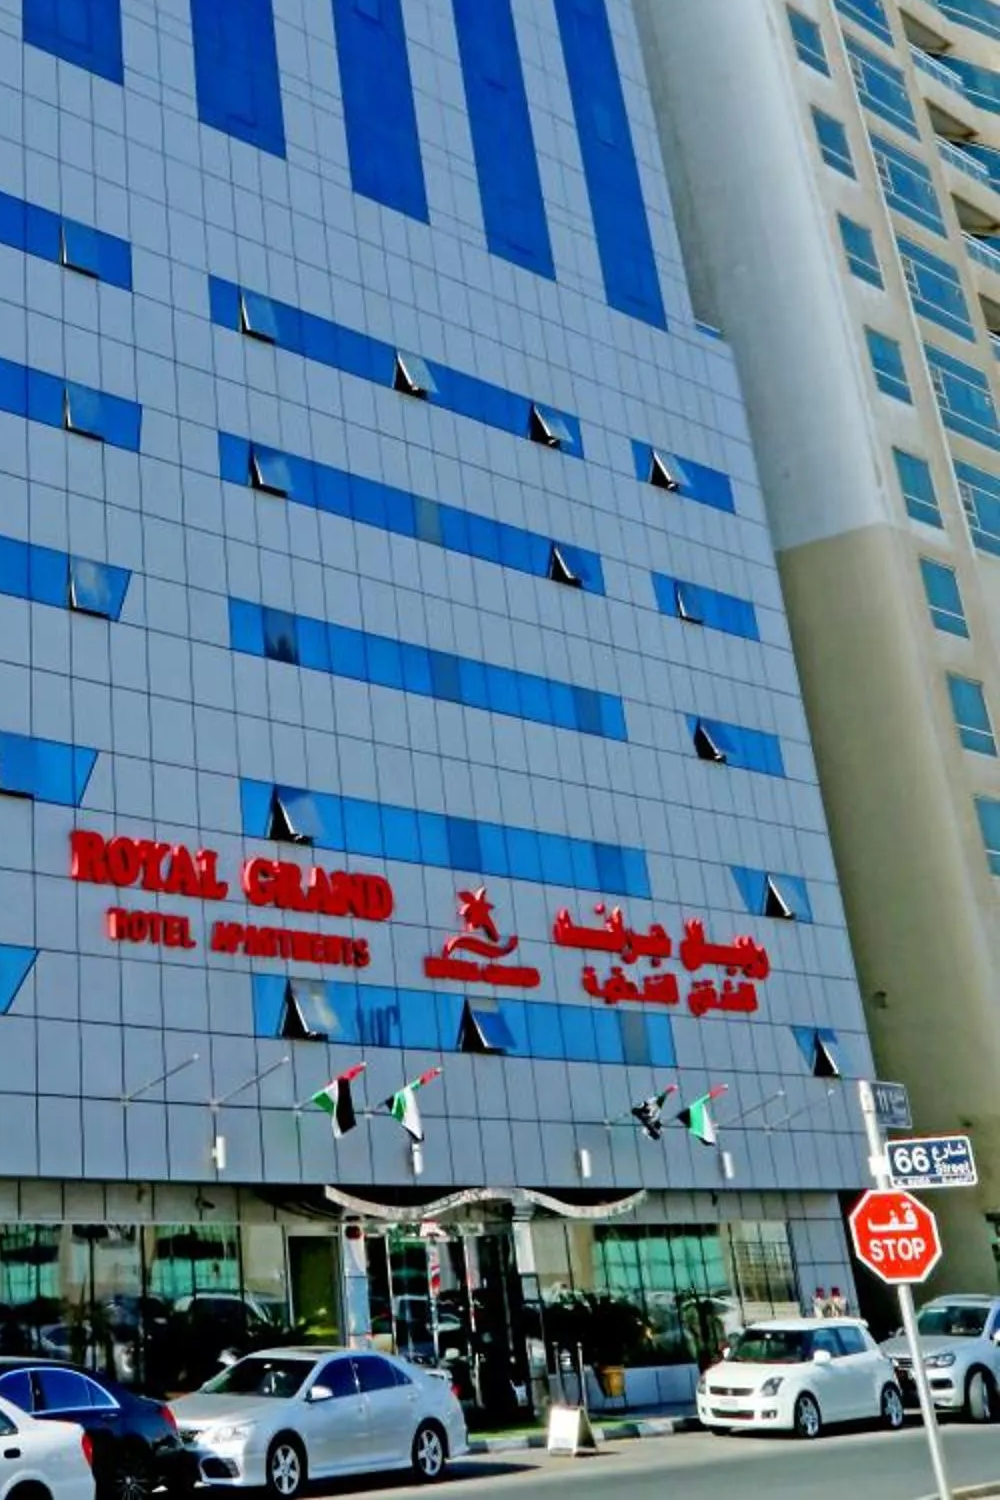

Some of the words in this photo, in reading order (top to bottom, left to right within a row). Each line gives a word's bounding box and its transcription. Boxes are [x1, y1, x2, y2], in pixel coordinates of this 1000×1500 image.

[69, 829, 228, 900] ROYAL
[243, 856, 394, 922] GRAND
[106, 906, 196, 948] HOTEL
[210, 920, 371, 968] APARTMENTS
[552, 902, 672, 967] جراند
[680, 917, 770, 979] رويال
[893, 1146, 931, 1174] 66
[931, 1142, 967, 1161] شارع
[934, 1160, 970, 1176] Street
[867, 1202, 919, 1232] قف
[869, 1237, 926, 1261] STOP
